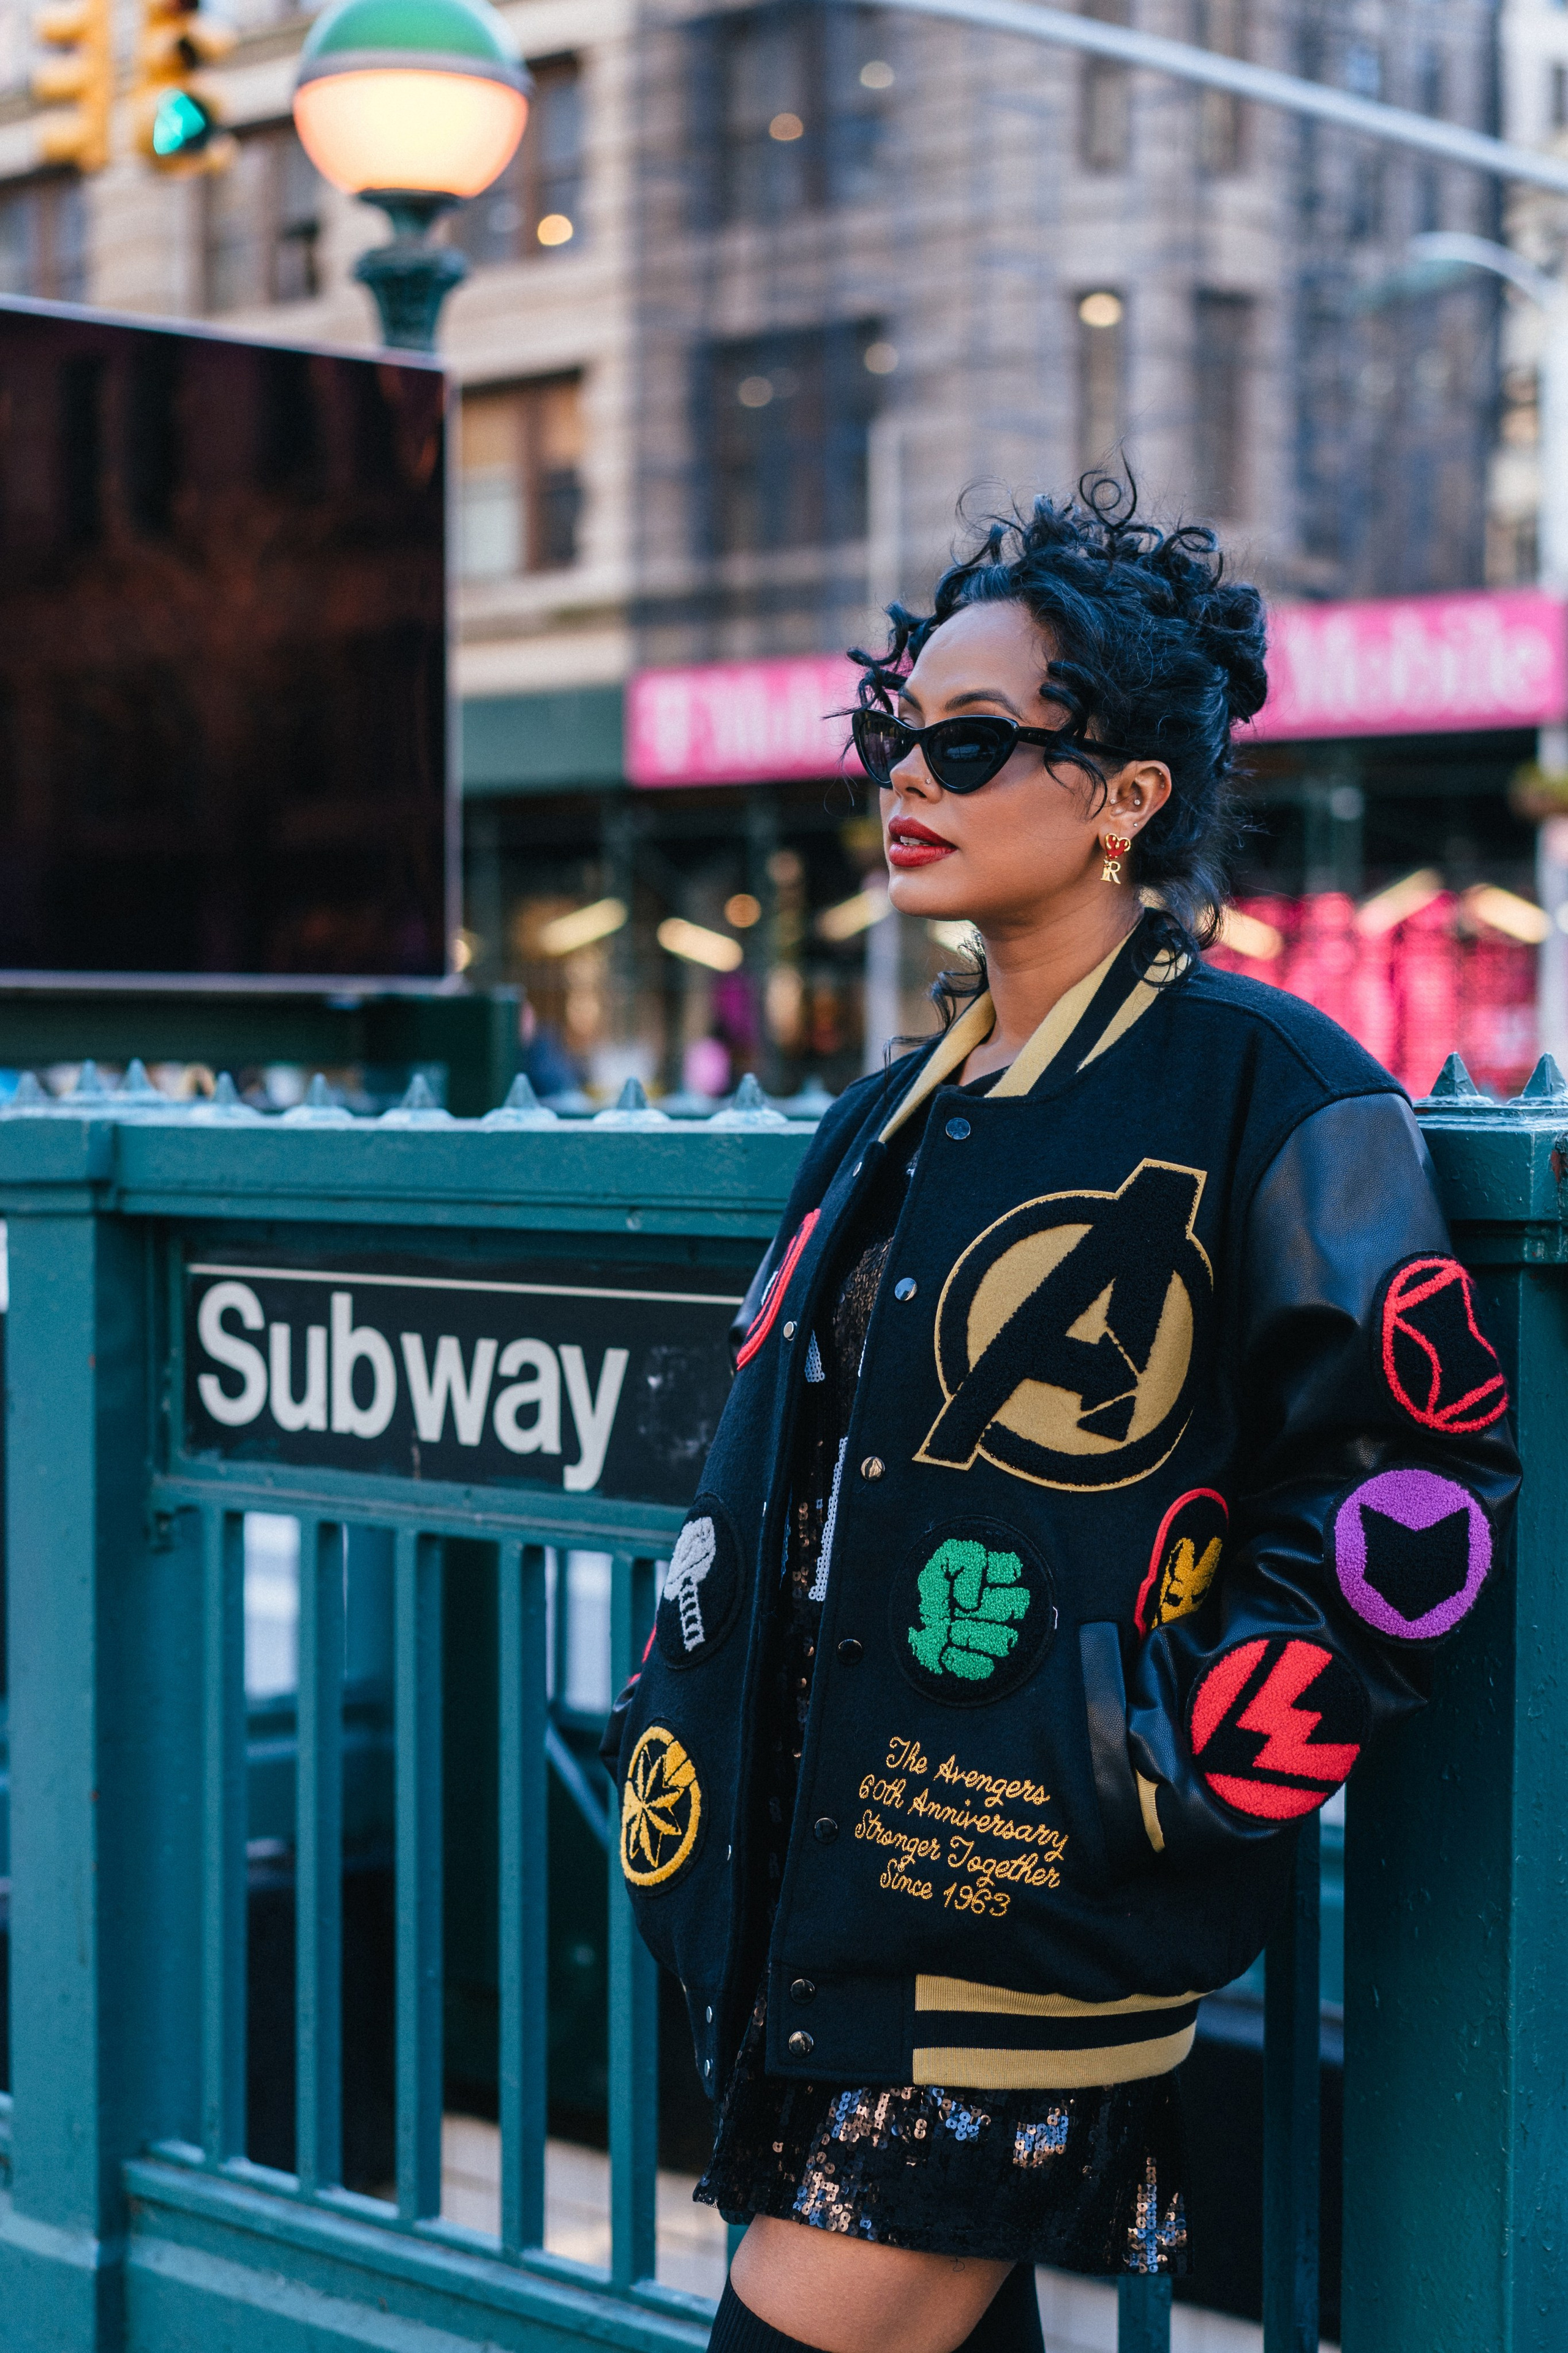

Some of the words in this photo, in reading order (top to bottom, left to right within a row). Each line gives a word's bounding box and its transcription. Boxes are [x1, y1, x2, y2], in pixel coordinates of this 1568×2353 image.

[1100, 859, 1121, 885] R
[197, 1281, 630, 1491] Subway
[886, 1736, 927, 1774] The
[933, 1754, 1050, 1807] Avengers
[854, 1809, 941, 1865] Stronger
[948, 1835, 1060, 1888] Together
[858, 1774, 907, 1808] 60th
[907, 1788, 1068, 1862] Anniversary
[880, 1858, 933, 1899] Since
[943, 1882, 1011, 1916] 1963
